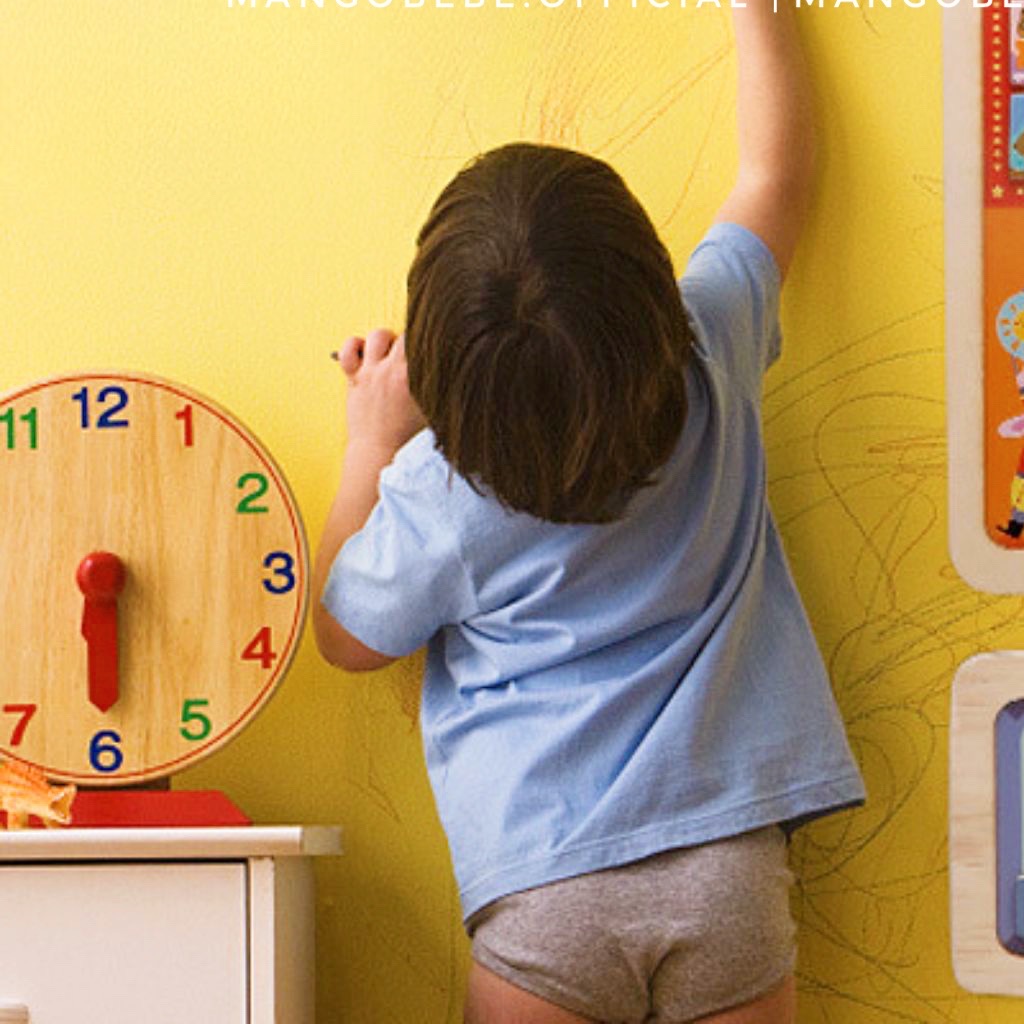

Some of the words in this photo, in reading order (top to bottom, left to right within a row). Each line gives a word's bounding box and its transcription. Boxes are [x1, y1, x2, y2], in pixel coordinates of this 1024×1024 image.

[0, 407, 38, 449] 11
[71, 386, 129, 429] 12
[175, 404, 194, 447] 1
[235, 473, 270, 514] 2
[261, 551, 296, 594] 3
[240, 626, 277, 669] 4
[2, 703, 37, 746] 7
[179, 699, 213, 741] 5
[89, 730, 123, 772] 6
